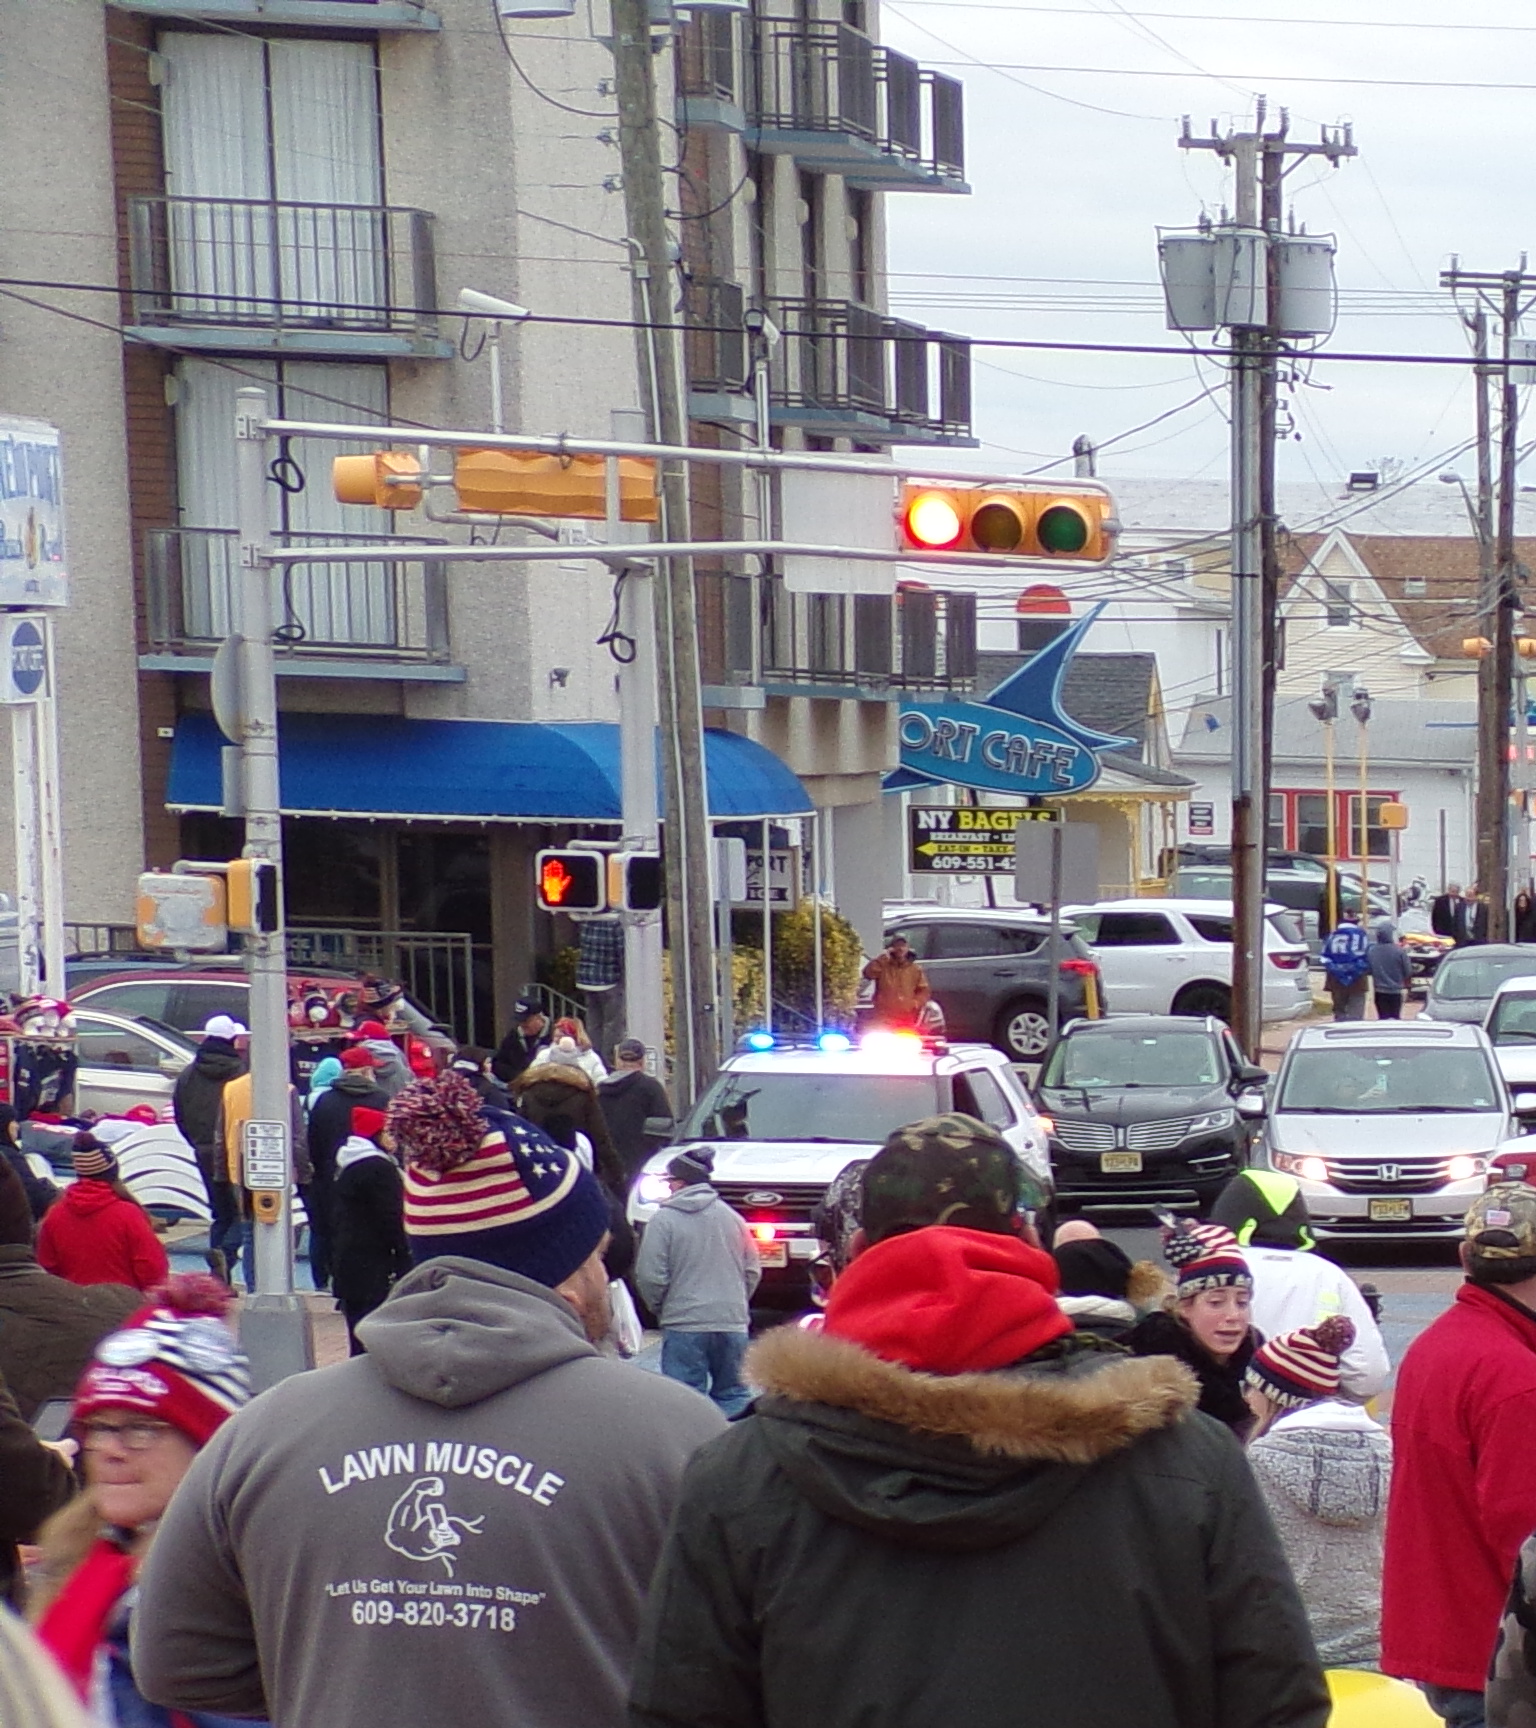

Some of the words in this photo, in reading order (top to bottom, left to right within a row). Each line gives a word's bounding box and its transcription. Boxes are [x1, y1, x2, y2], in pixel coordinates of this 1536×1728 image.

[981, 730, 1079, 787] CAFE
[917, 811, 953, 829] NY
[318, 1442, 416, 1494] LAWN
[425, 1442, 566, 1506] MUSCLE
[352, 1580, 367, 1594] Us
[370, 1580, 394, 1594] Get
[397, 1580, 427, 1596] Your
[430, 1582, 463, 1597] Lawn
[466, 1584, 493, 1599] Into
[352, 1600, 516, 1632] 609-820-3718
